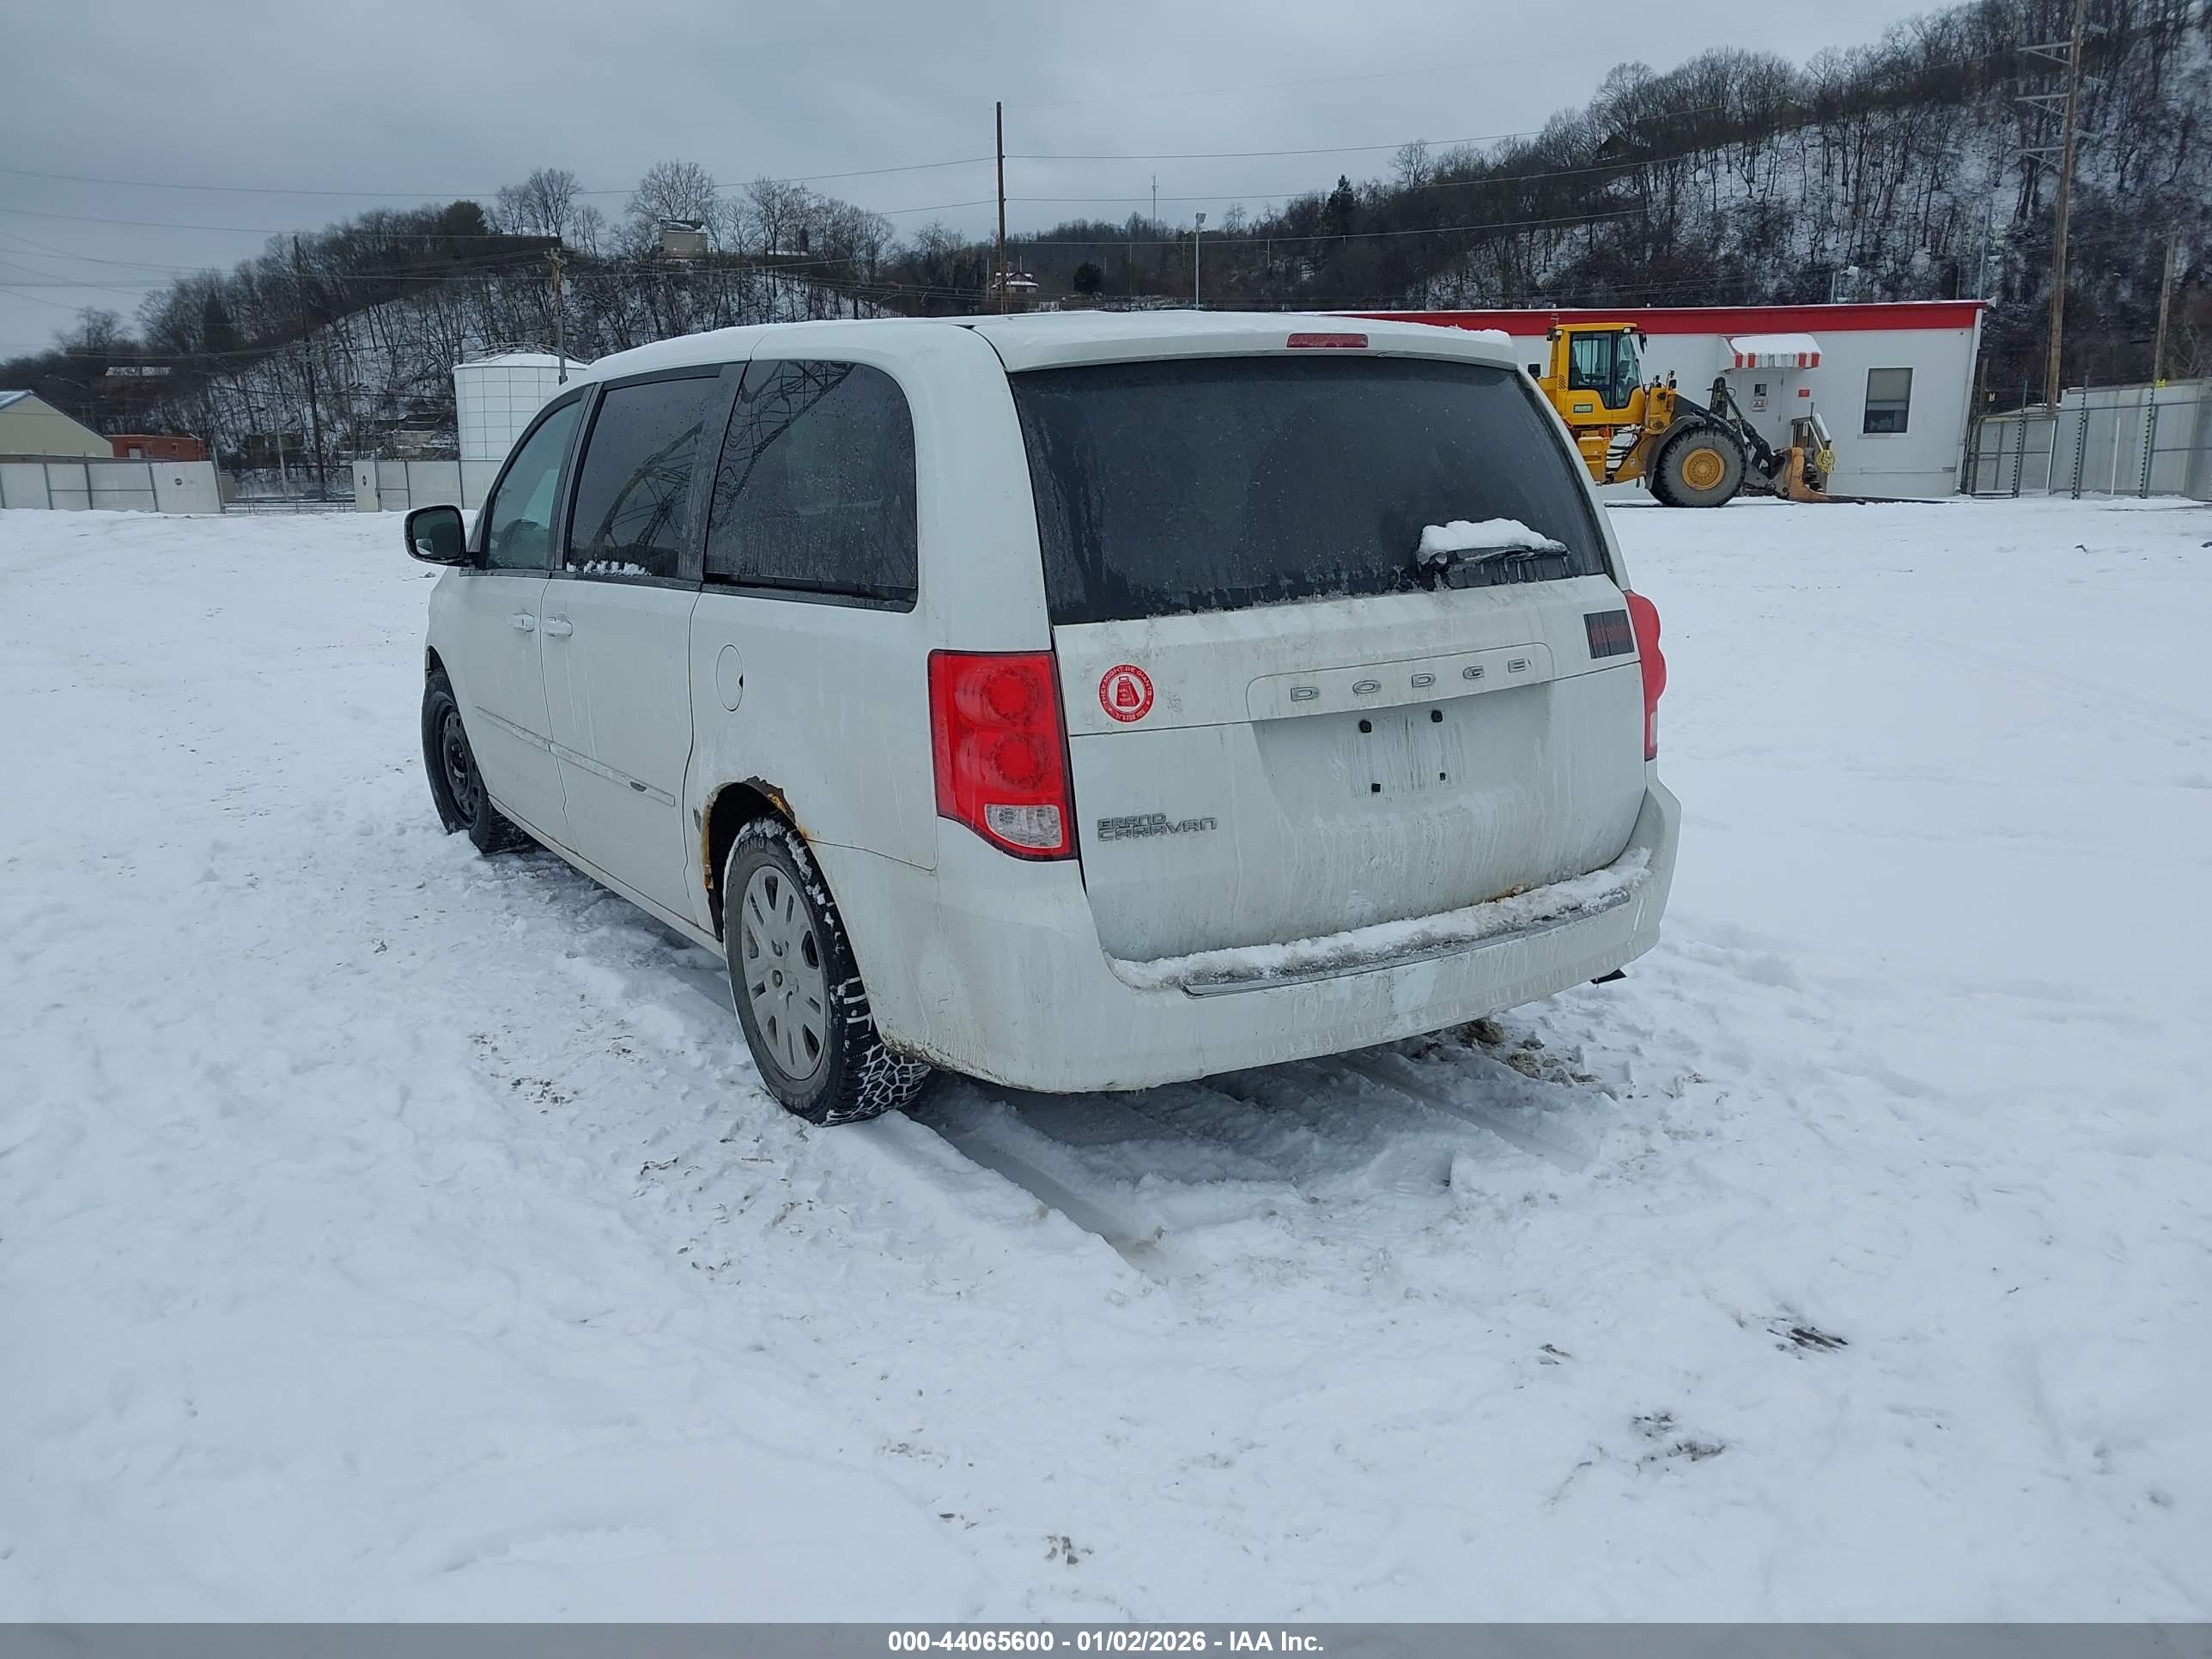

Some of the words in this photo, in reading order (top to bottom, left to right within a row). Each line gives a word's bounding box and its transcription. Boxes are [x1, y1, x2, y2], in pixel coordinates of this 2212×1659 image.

[1103, 666, 1124, 684] MIGHT
[1136, 670, 1152, 696] GIANTS
[1290, 659, 1526, 702] DODGE
[1097, 812, 1167, 830] GRAND
[1098, 817, 1218, 842] CARAVAN
